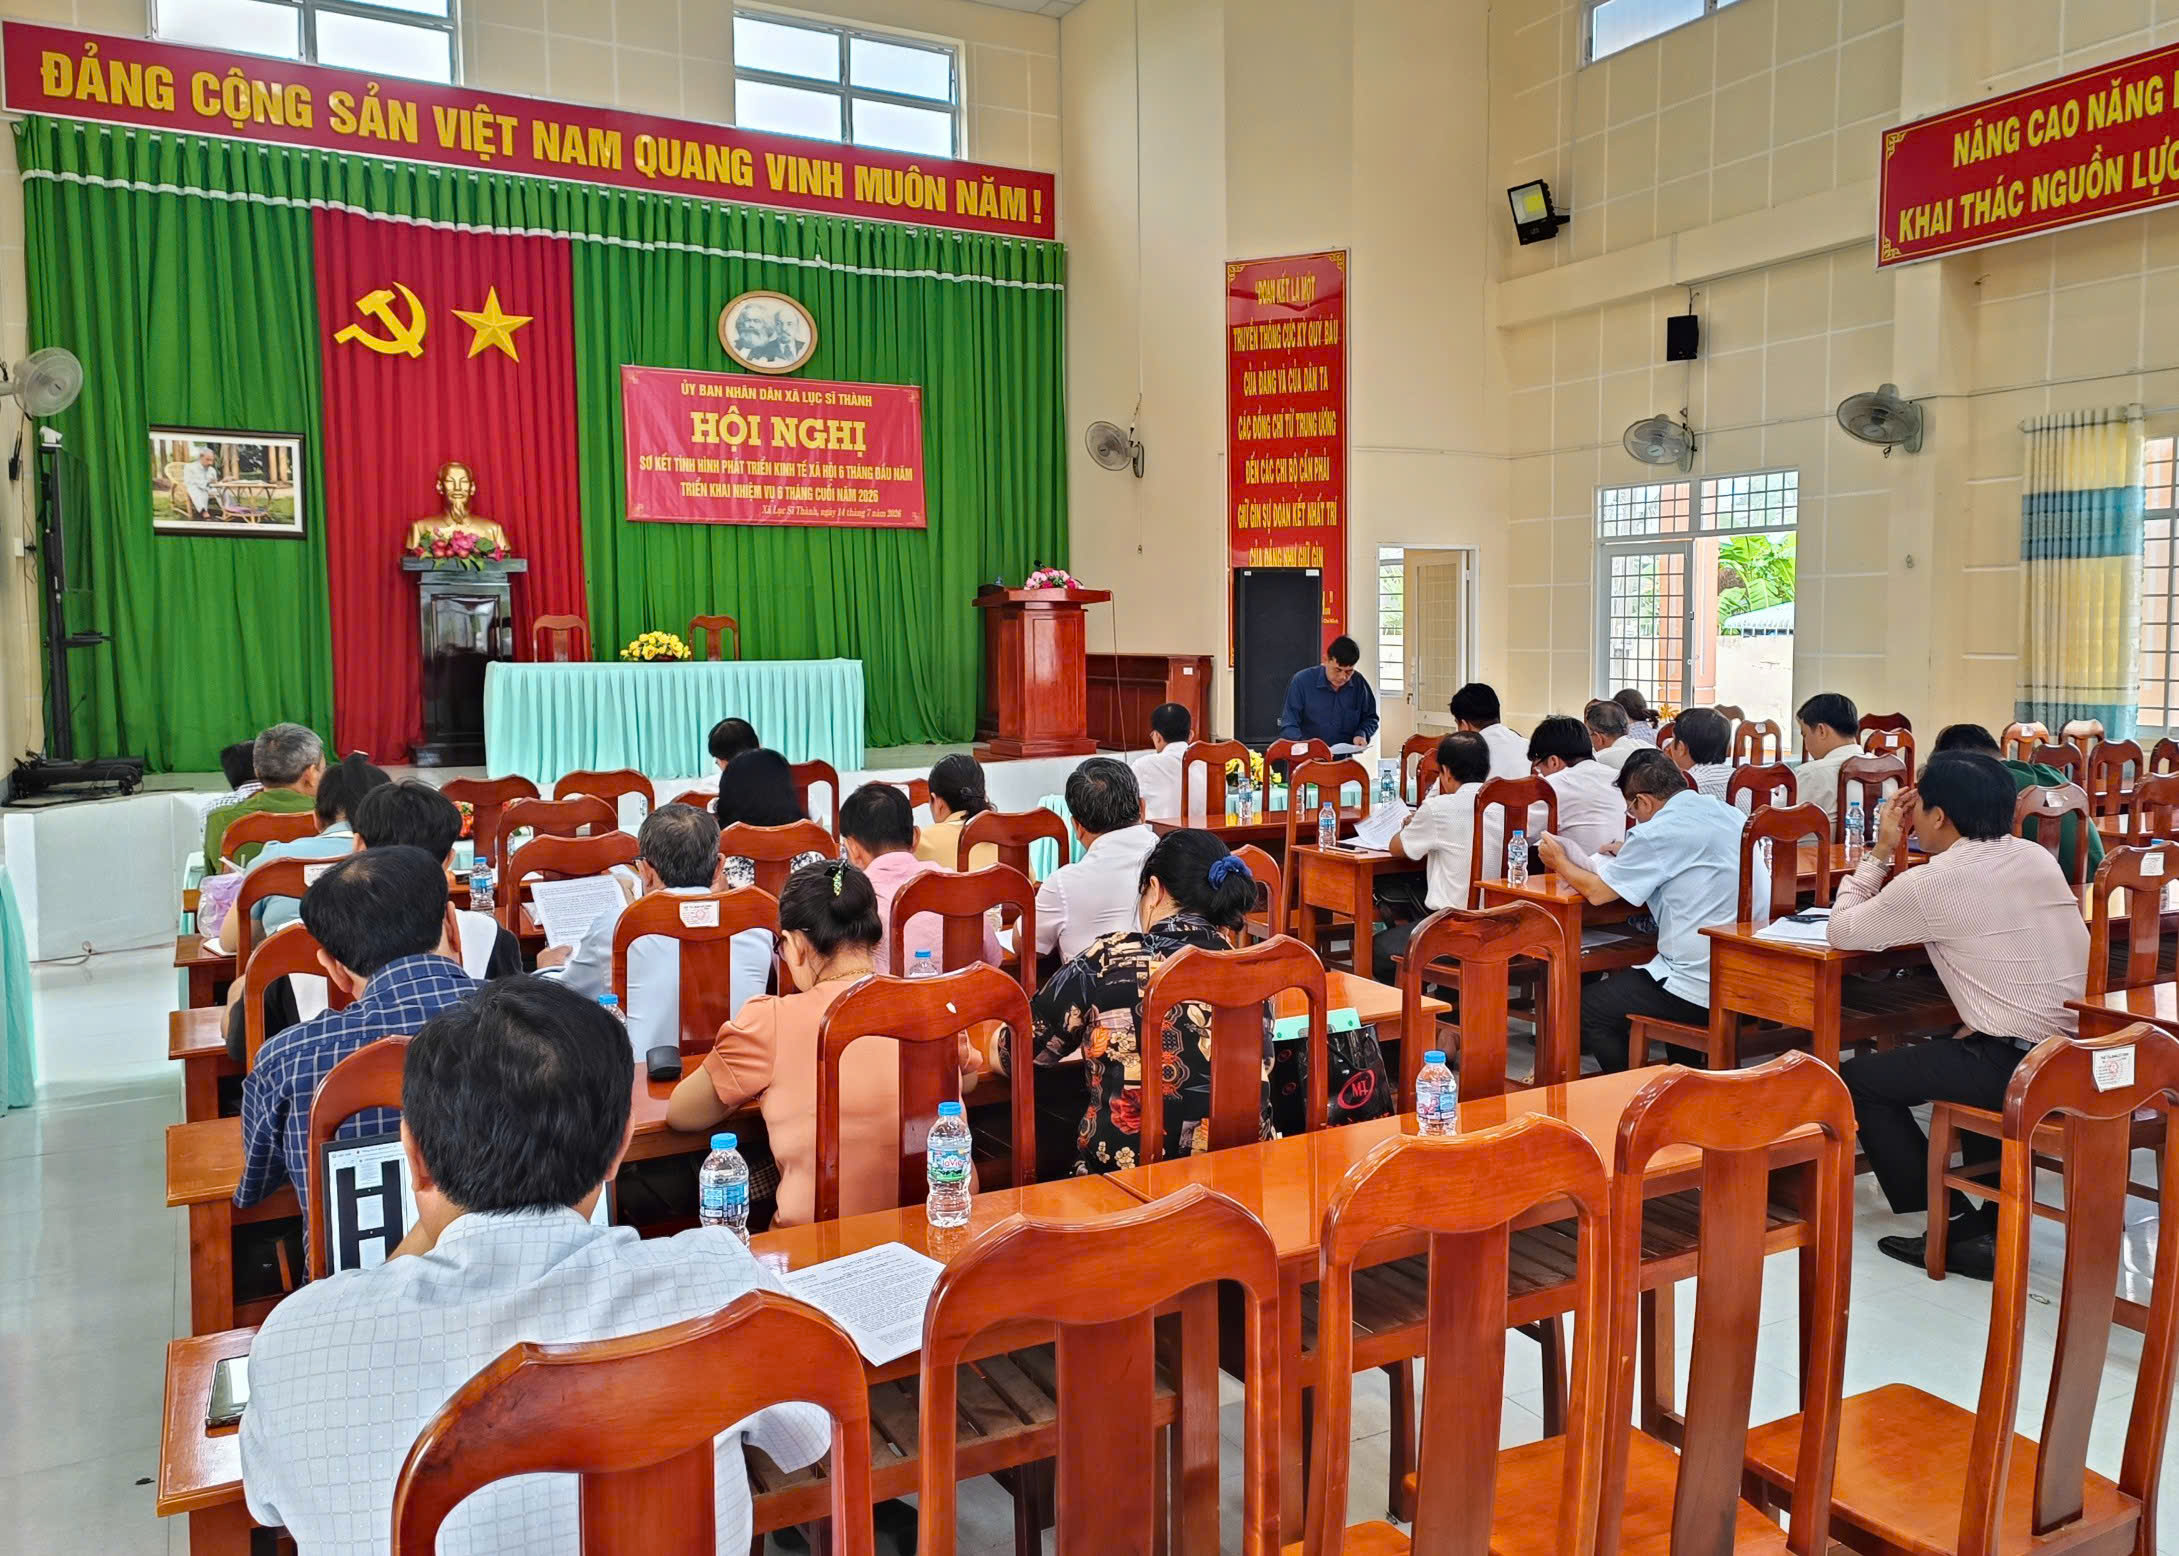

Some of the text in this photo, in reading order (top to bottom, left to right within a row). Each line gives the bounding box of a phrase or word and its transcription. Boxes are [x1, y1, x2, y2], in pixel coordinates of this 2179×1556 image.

[40, 42, 175, 112] ĐẢNG
[191, 67, 313, 129] CỘNG
[329, 82, 418, 144] SẢN
[432, 104, 518, 161] VIỆT
[533, 120, 622, 170] NAM
[633, 135, 753, 188] QUANG
[765, 152, 844, 199] VINH
[855, 164, 947, 212] MUÔN
[1953, 116, 2021, 168] NÂNG
[2028, 99, 2080, 148] CAO
[2087, 75, 2164, 132] NĂNG
[1899, 135, 2179, 244] KHAI THÁC NGUỒN LỰC
[681, 379, 873, 407] ỦY BAN NHÂN DÂN XÃ LỤC SĨ THÀNH
[690, 405, 866, 458] HỘI NGHỊ
[655, 452, 672, 472] KẾT
[673, 455, 696, 473] TÌNH
[697, 456, 720, 474] HÌNH
[721, 457, 744, 474] PHÁT
[746, 456, 773, 476] TRIỂN
[774, 461, 796, 477] KINH
[797, 459, 808, 477] TẾ
[809, 461, 820, 478] XÃ
[822, 461, 837, 482] HỘI
[838, 464, 844, 479] 6
[845, 463, 873, 480] THÁNG
[893, 465, 913, 481] NĂM
[680, 477, 879, 503] TRIỂN KHAI NHIỆM VỤ 6 THÁNG CUỐI NĂM 2026
